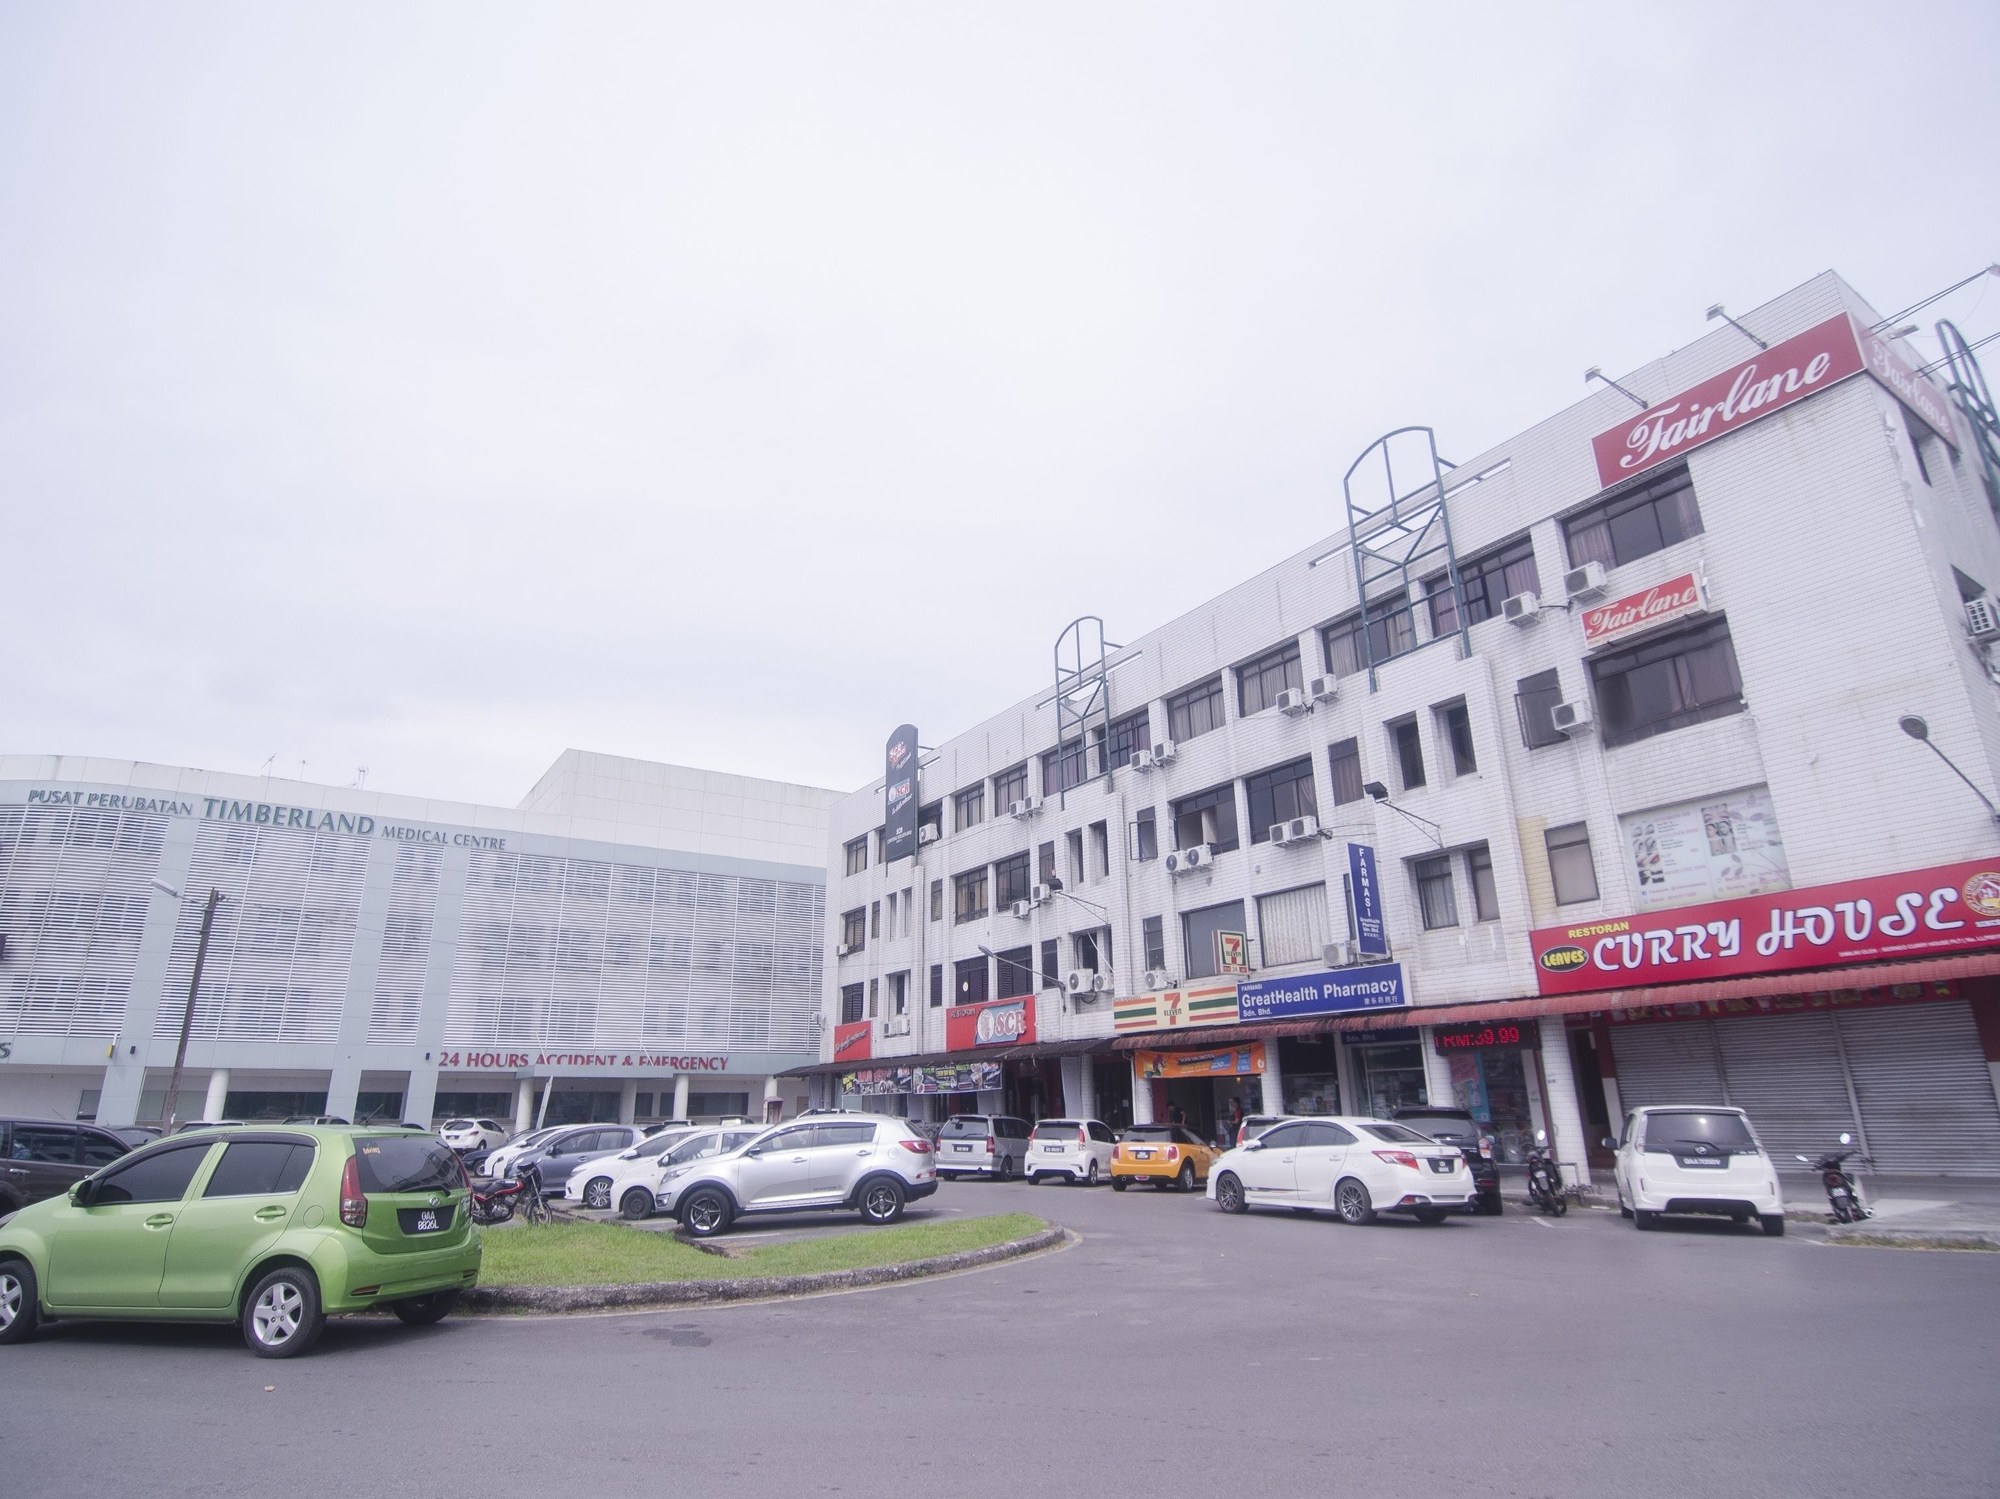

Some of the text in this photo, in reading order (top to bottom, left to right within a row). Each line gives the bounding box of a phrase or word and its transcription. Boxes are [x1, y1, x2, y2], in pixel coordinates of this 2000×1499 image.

[1619, 352, 1830, 468] Fairlane
[1586, 586, 1695, 637] Fairlane
[28, 789, 506, 850] PUSAT PERUBATAN TIMBERLAND MEDICAL CENTRE
[1358, 848, 1371, 917] FARMASI
[1568, 921, 1630, 939] RESTORAN
[1593, 918, 1741, 971] CURRY
[1756, 887, 1965, 956] HOUSE
[1543, 950, 1585, 967] LEAVES
[1241, 984, 1262, 992] FARMASI
[1242, 979, 1398, 1008] GreatHealth Pharmacy
[994, 1009, 1027, 1037] SCR
[1243, 1007, 1273, 1018] Sdn. Bhd.
[438, 1052, 460, 1067] 24
[466, 1052, 529, 1068] HOURS
[535, 1053, 617, 1066] ACCIDENT
[638, 1055, 729, 1071] EMERGENCY
[417, 1220, 439, 1230] 8826L
